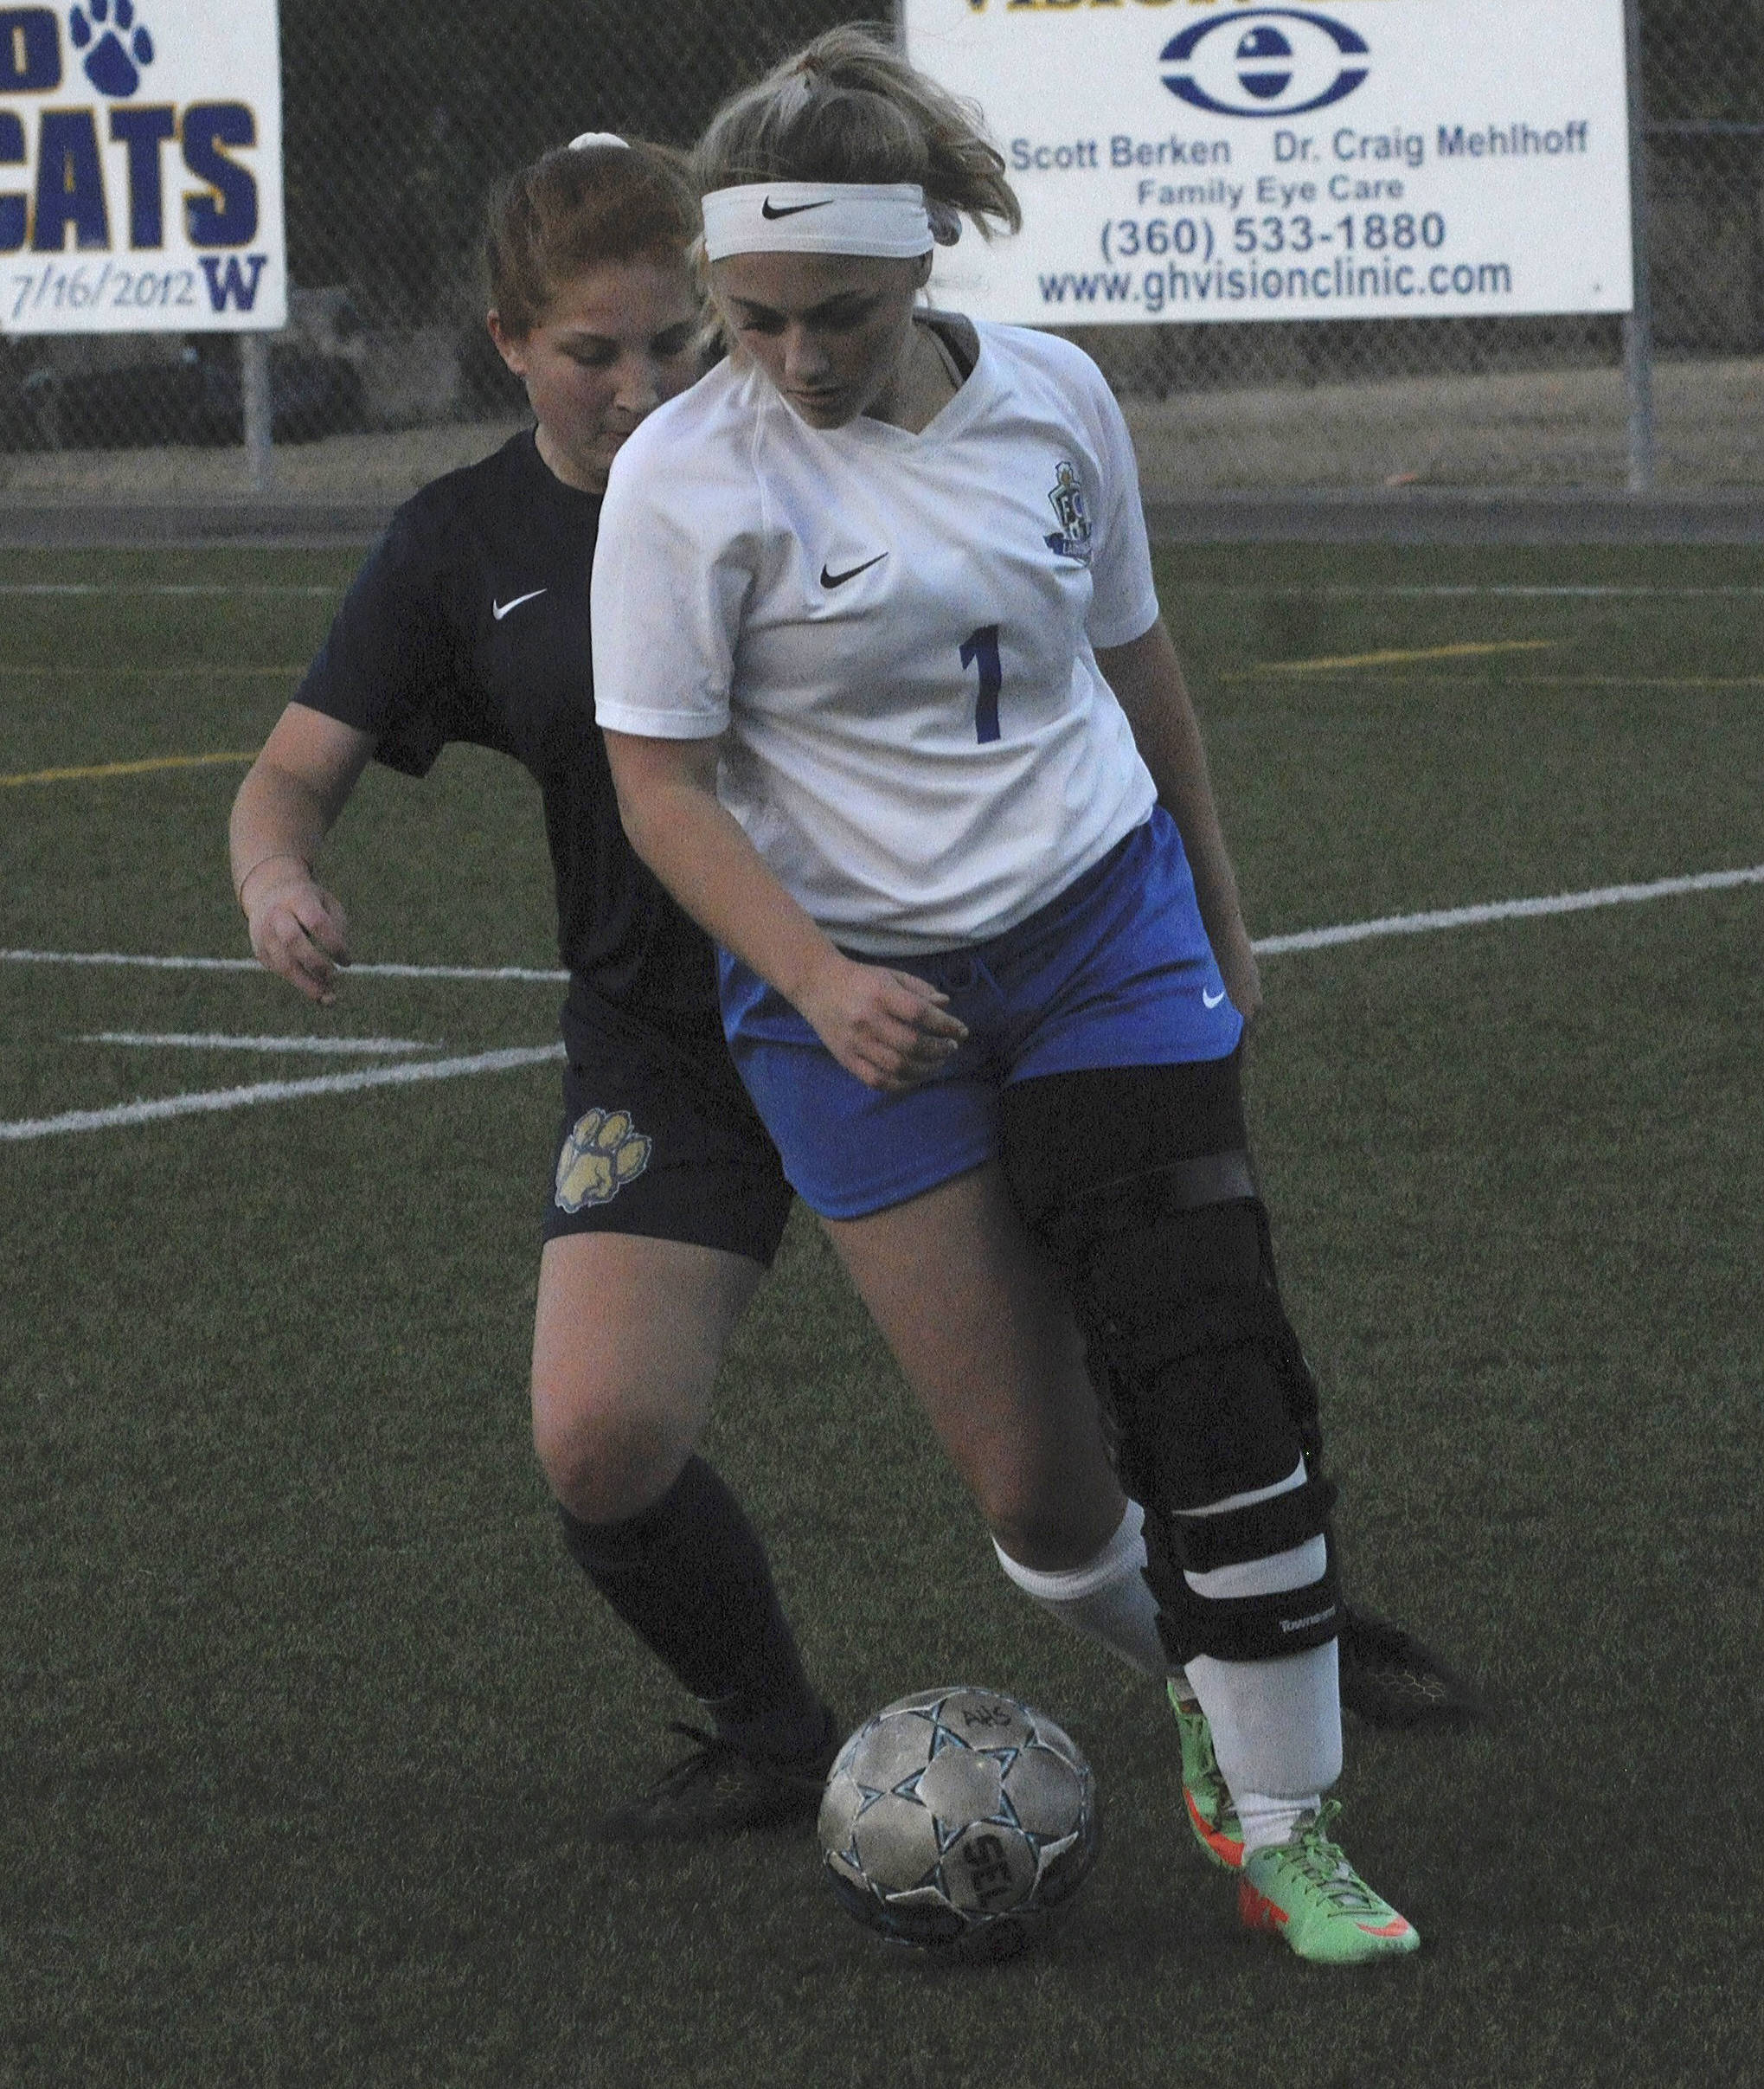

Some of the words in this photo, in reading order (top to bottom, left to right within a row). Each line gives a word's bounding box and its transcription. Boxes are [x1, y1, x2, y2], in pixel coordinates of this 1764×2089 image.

[1010, 138, 1098, 170] Scott
[1110, 134, 1231, 168] Berken
[1273, 129, 1319, 163] Dr.
[1332, 127, 1424, 168] Craig
[1437, 120, 1588, 157] Mehlhoff
[1138, 177, 1243, 210] Family
[1257, 176, 1318, 209] Eye
[1329, 174, 1404, 202] Care
[1100, 217, 1215, 264] (360)
[1235, 212, 1446, 254] 533-1880
[12, 261, 196, 318] 7/16/2012
[198, 254, 266, 312] W
[1038, 258, 1512, 313] www.ghvisionclinic.com
[959, 624, 1002, 744] 1
